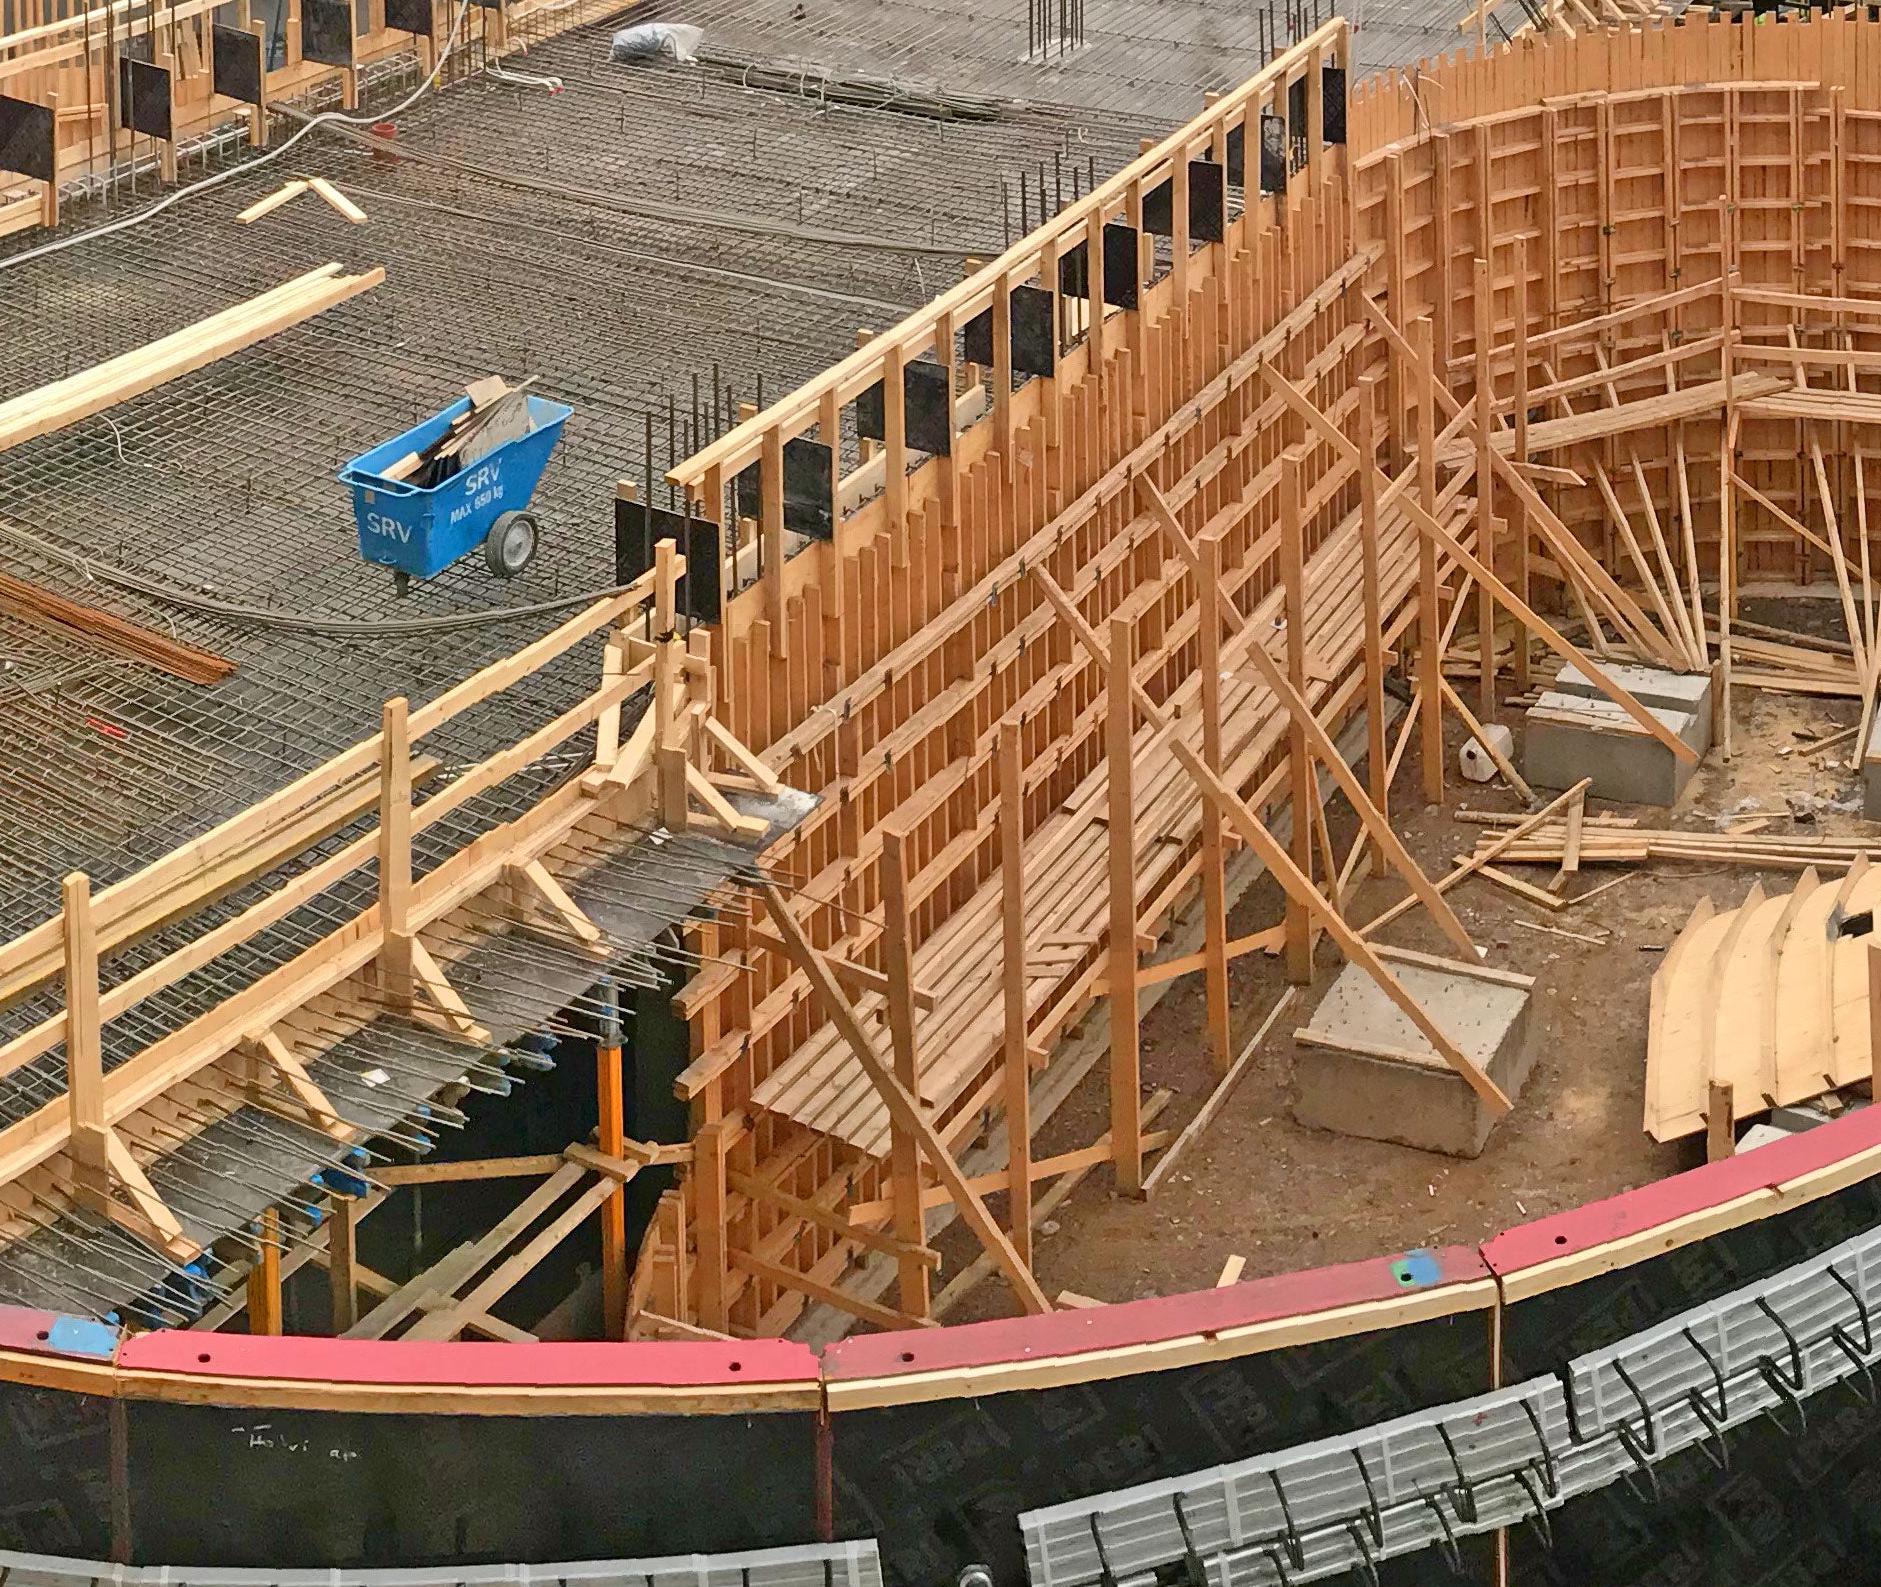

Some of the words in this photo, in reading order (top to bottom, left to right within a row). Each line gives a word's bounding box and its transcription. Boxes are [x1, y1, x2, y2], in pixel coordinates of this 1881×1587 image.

[465, 460, 502, 497] SRV
[450, 502, 472, 524] MAX
[474, 493, 492, 510] 650
[493, 484, 504, 500] kg
[366, 512, 412, 545] SRV
